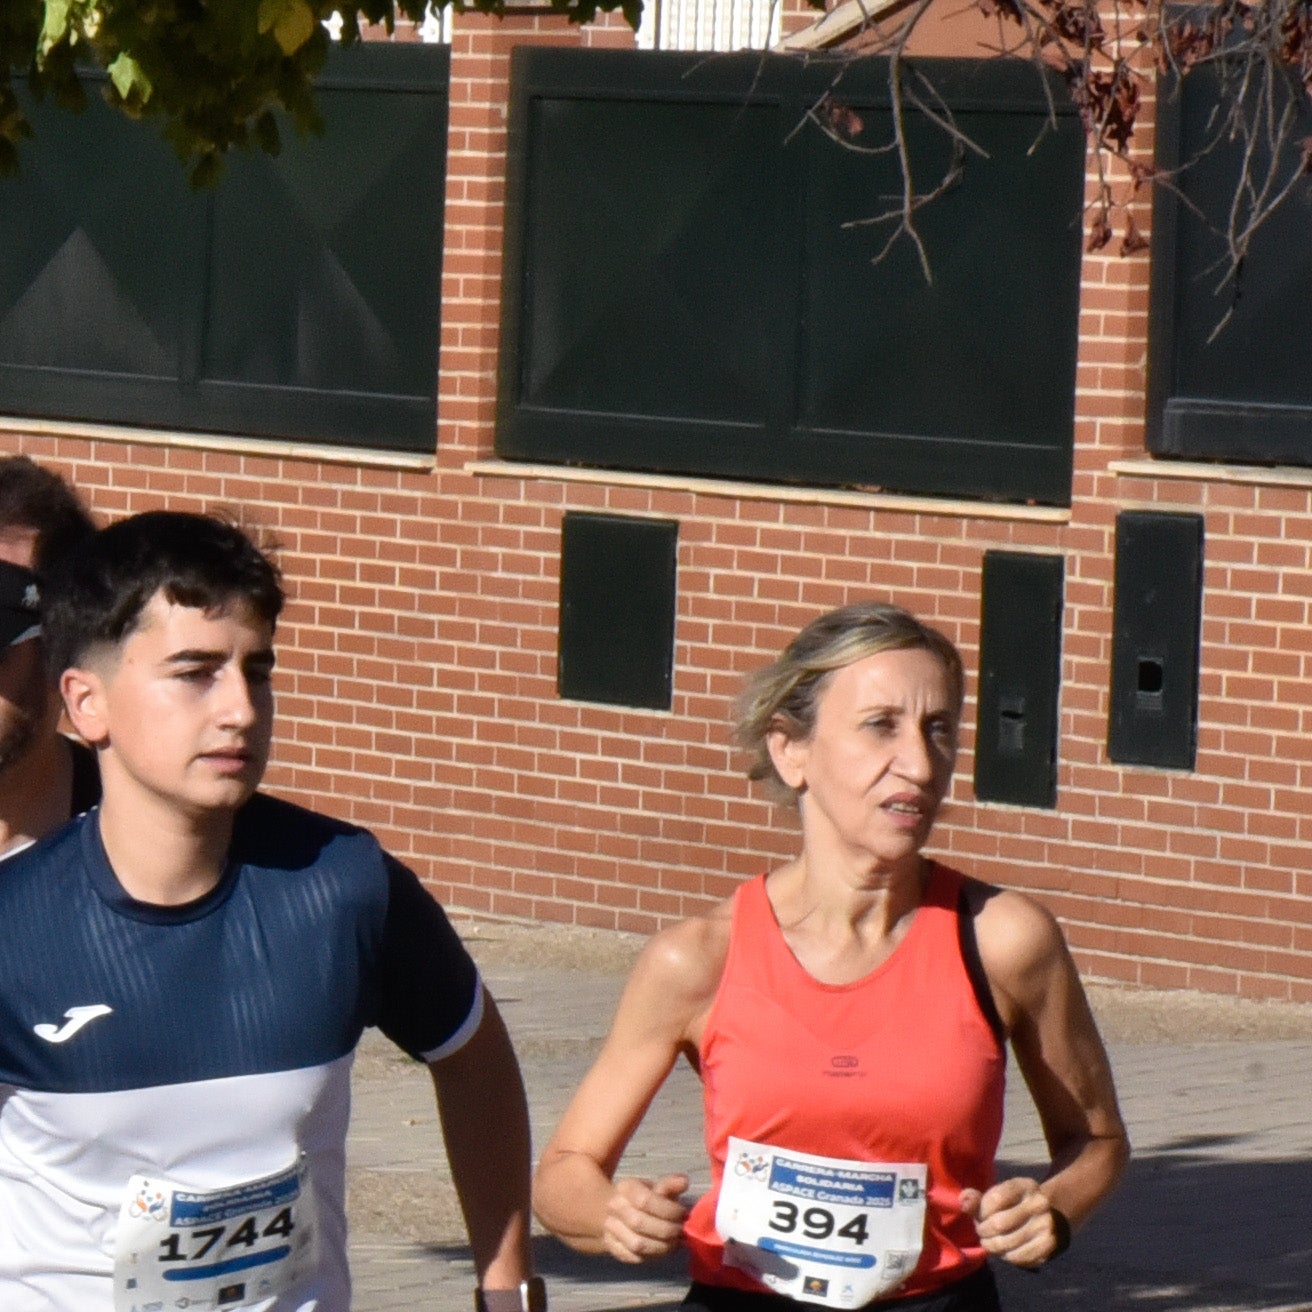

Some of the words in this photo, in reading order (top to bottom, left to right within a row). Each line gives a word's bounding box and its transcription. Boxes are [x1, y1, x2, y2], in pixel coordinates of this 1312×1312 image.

[771, 1180, 816, 1199] ASPACE
[816, 1190, 865, 1206] Granada
[796, 1173, 865, 1193] SOLIDARIA
[158, 1206, 296, 1263] 1744
[768, 1199, 870, 1246] 394
